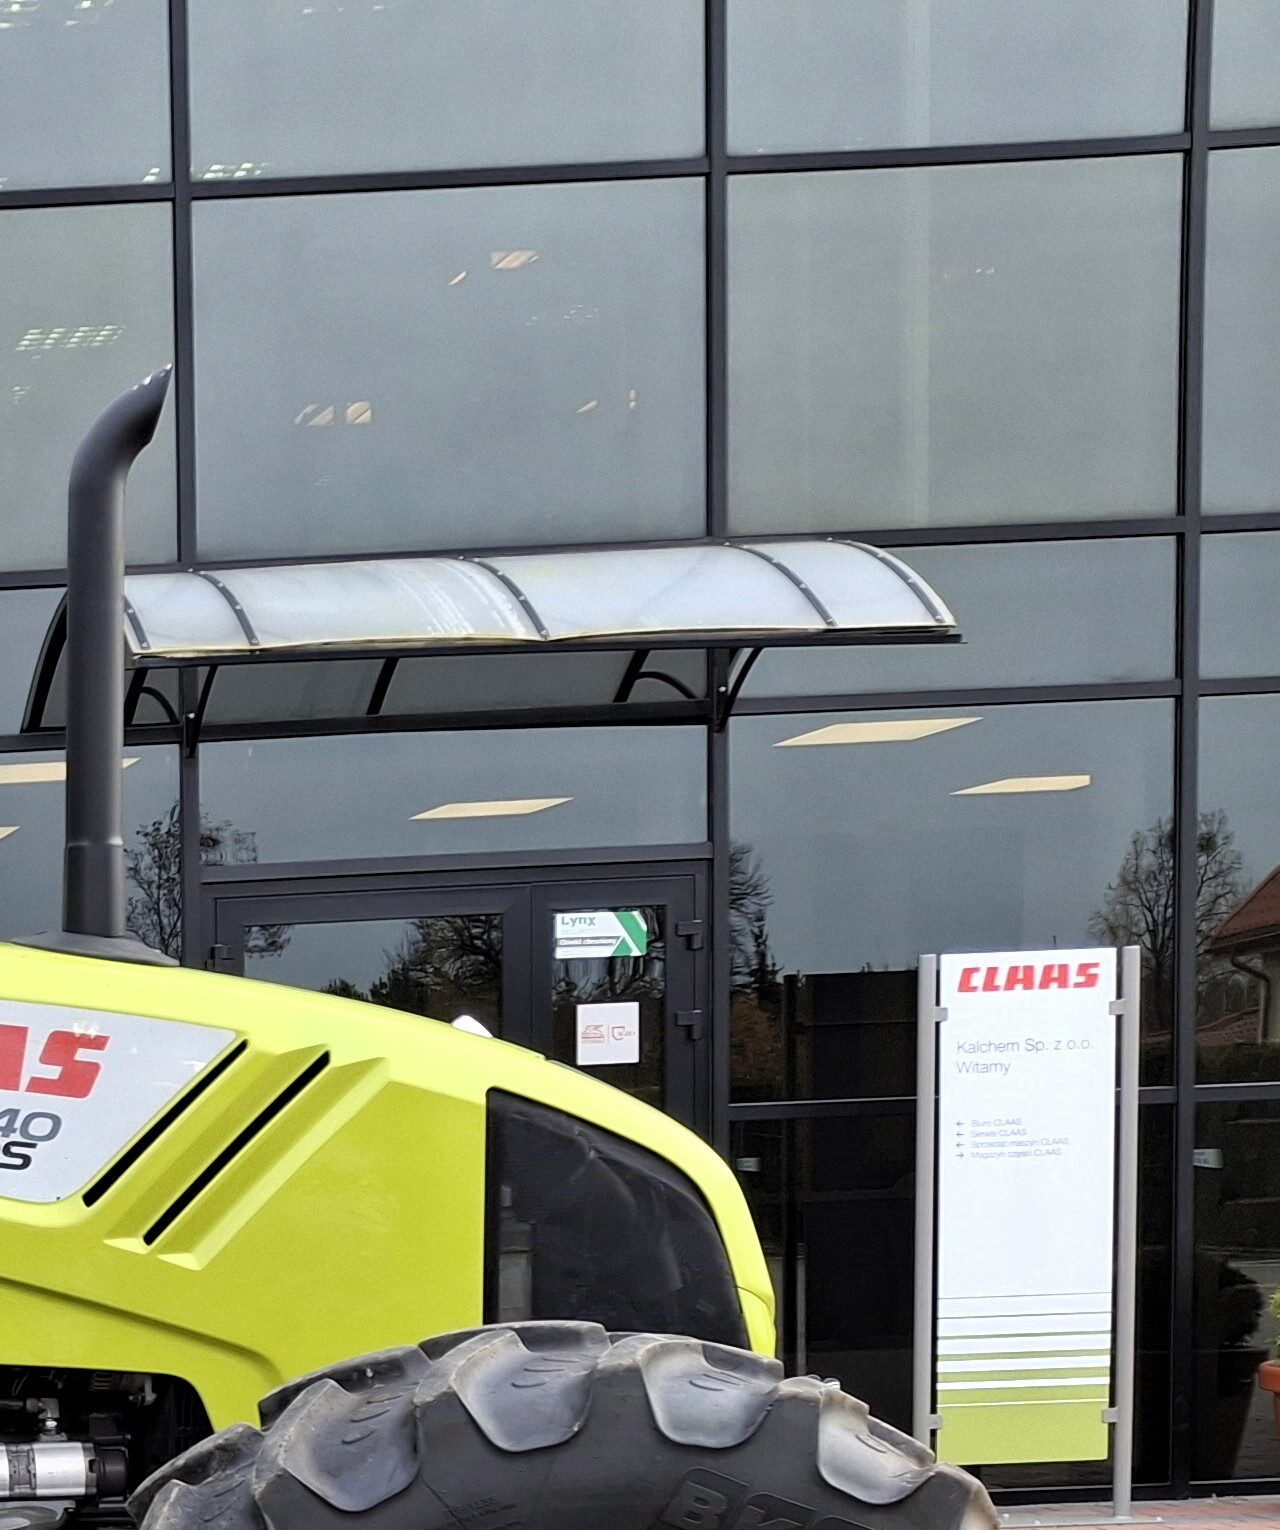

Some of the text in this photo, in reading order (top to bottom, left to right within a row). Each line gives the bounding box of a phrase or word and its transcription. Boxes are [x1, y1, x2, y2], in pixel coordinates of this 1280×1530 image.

[560, 916, 597, 927] Lynx
[957, 962, 1101, 993] CLAAS
[956, 1038, 1094, 1054] Kalchem Sp. z o.o.
[956, 1060, 1011, 1075] Witamy
[993, 1117, 1022, 1127] CLAAS
[999, 1128, 1027, 1137] CLAAS
